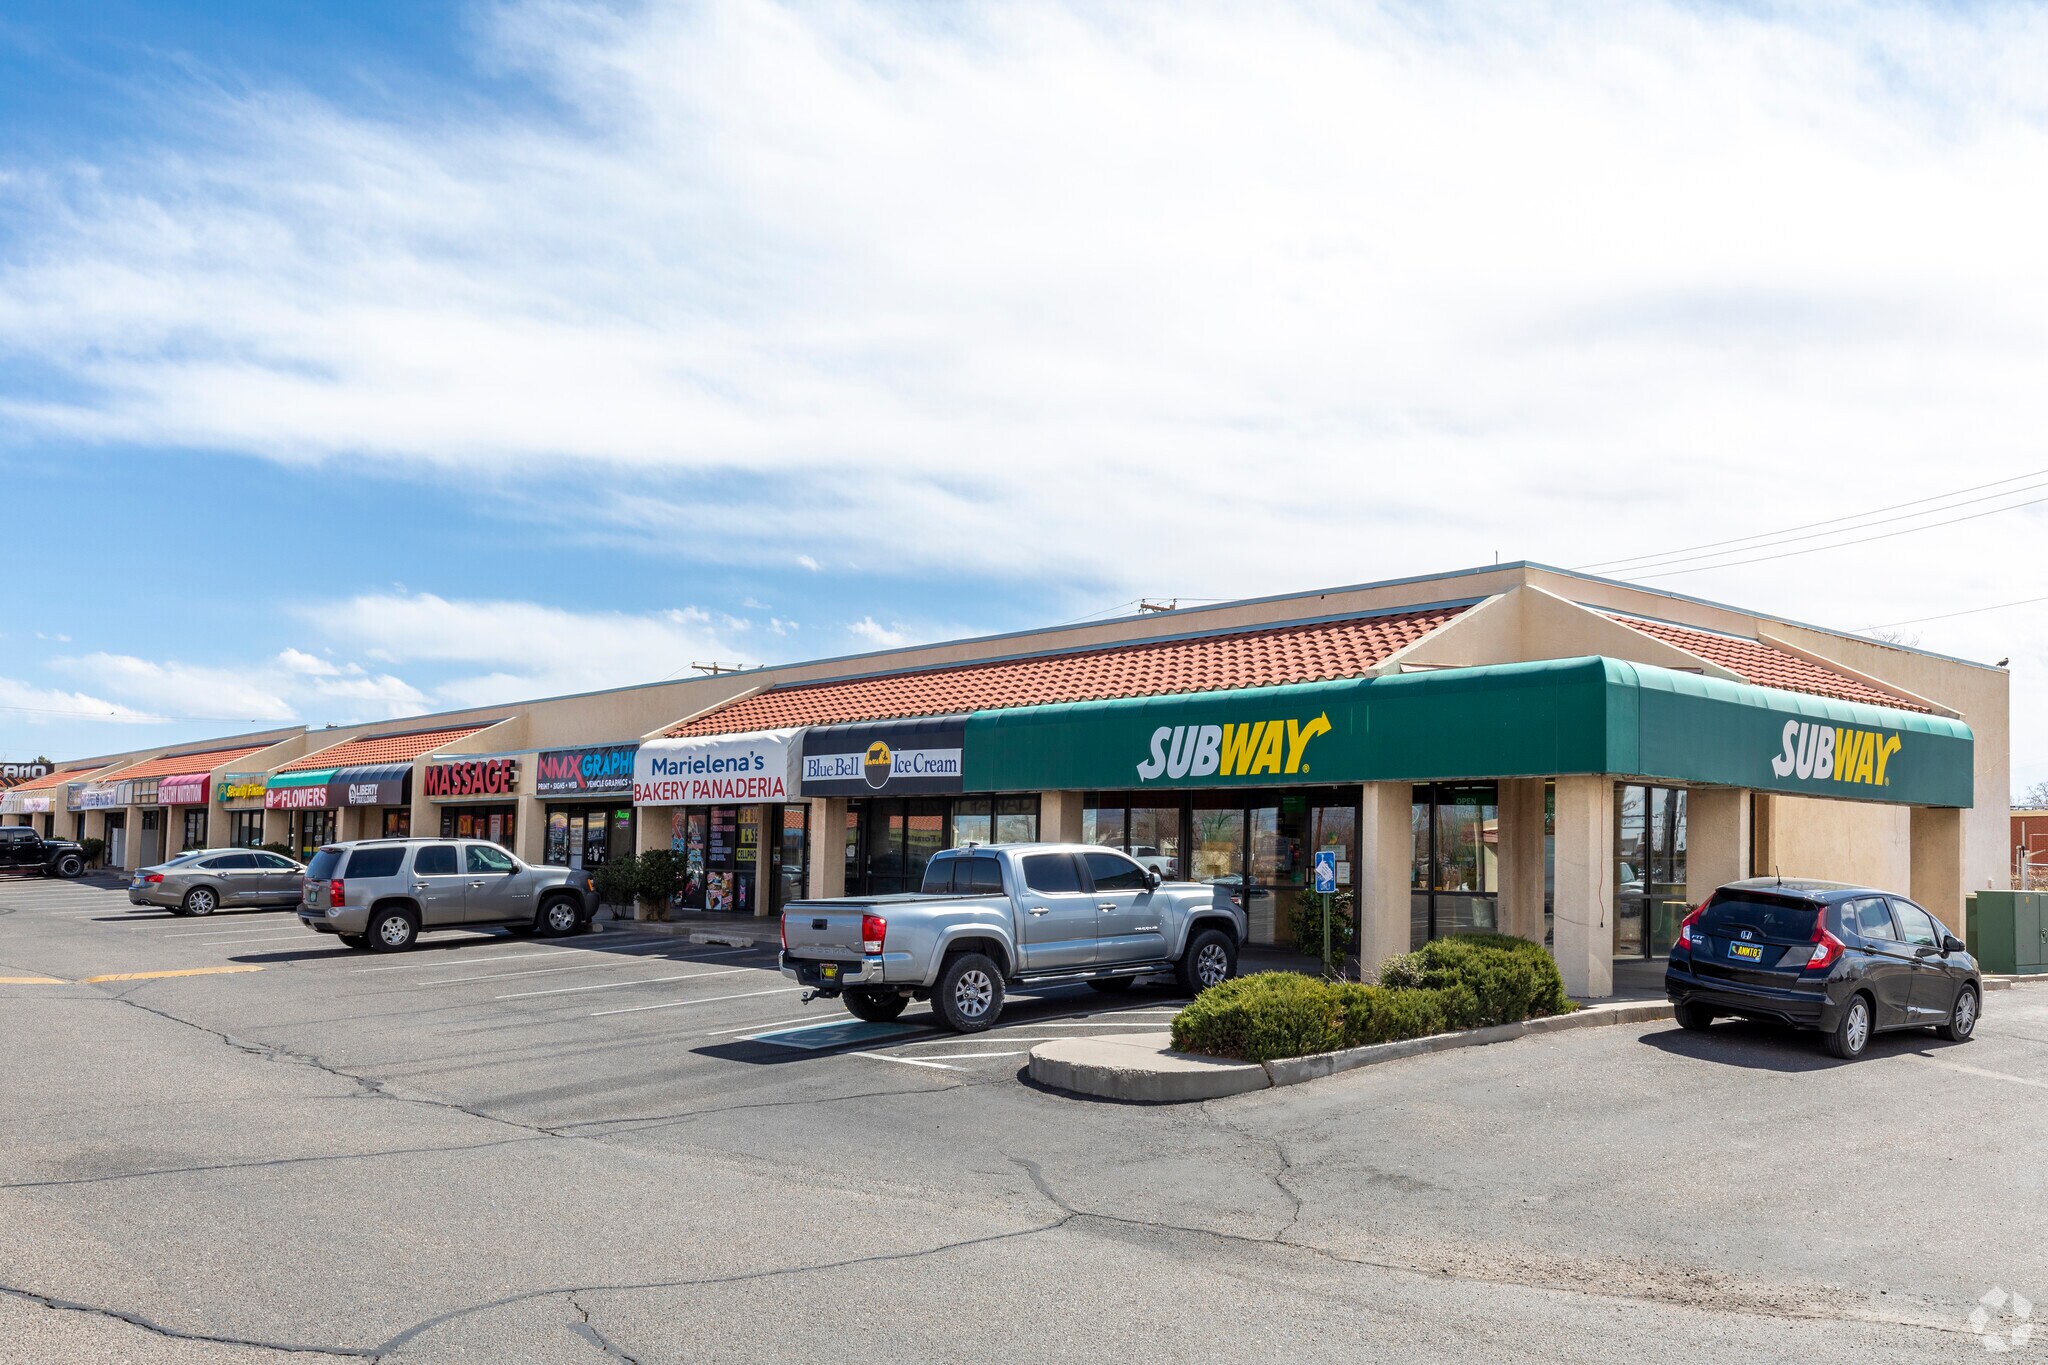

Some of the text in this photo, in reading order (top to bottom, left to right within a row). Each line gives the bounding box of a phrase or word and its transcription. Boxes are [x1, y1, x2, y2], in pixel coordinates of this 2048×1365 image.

[1136, 711, 1332, 783] SUBWAY
[1771, 719, 1902, 786] SUBWAY
[582, 751, 634, 777] GRAPHI
[651, 750, 764, 775] Marielena's
[807, 756, 859, 778] Blue Bell
[893, 753, 958, 774] Ice Cream
[424, 759, 513, 797] MASSAGE
[634, 776, 785, 802] BAKERY PANADERIA
[281, 787, 327, 808] FLOWERS
[356, 784, 379, 796] LIBERTY
[1456, 797, 1477, 805] OPEN
[737, 849, 757, 860] CELLPHO
